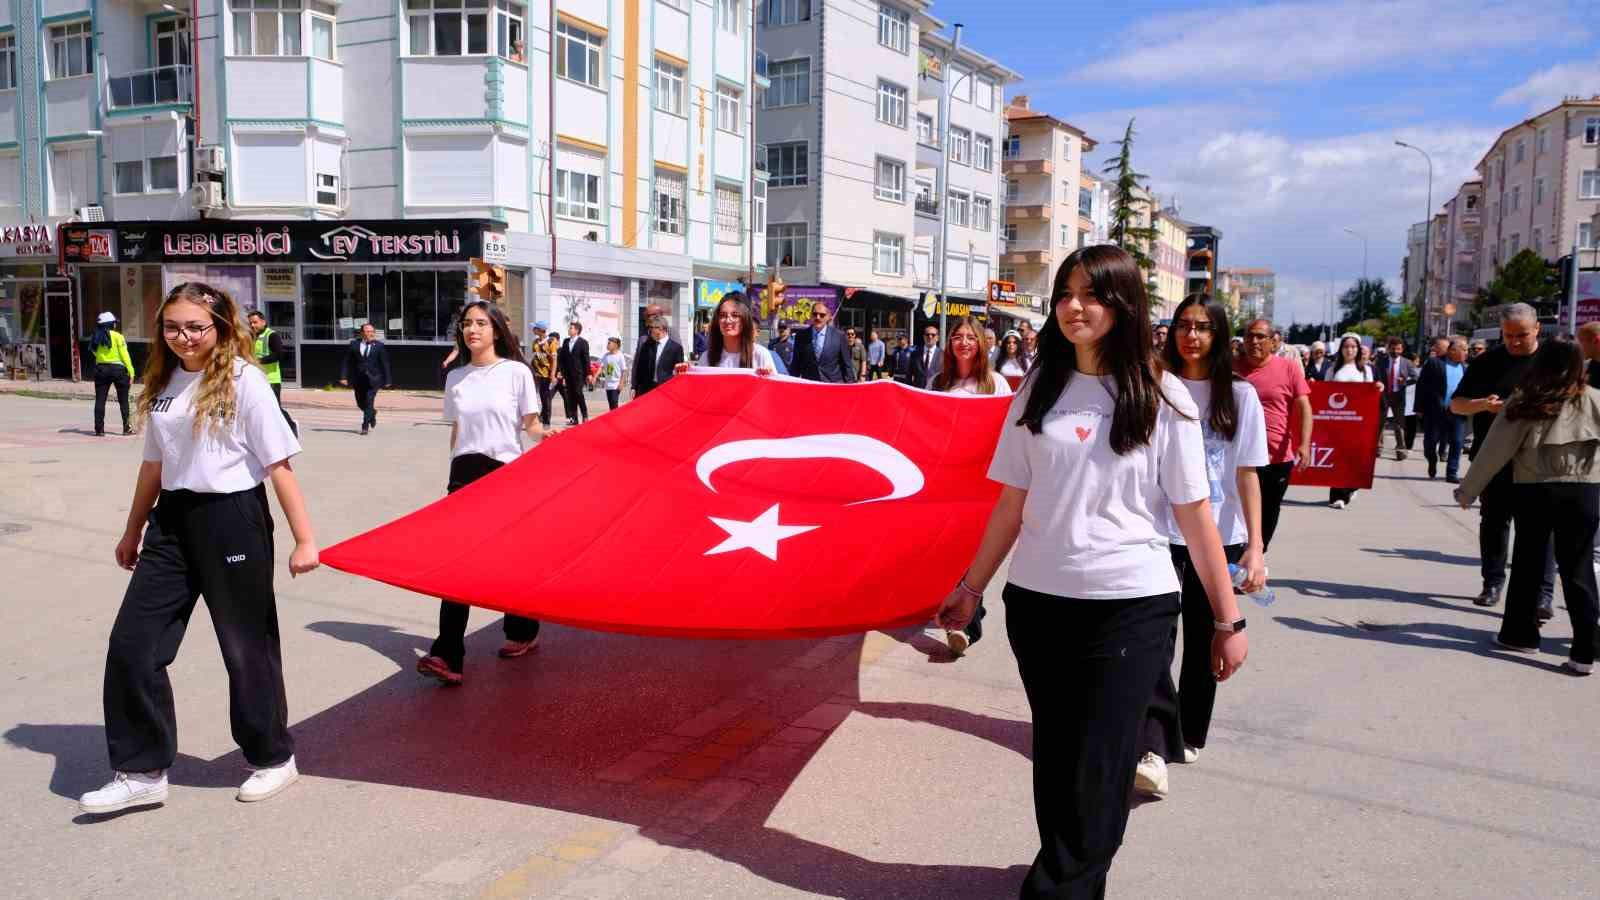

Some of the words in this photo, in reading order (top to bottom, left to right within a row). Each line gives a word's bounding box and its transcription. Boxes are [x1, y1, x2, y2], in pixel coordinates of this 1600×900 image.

[163, 226, 291, 255] LEBLEBİCİ
[333, 236, 358, 254] EV
[368, 229, 460, 254] TEKSTİLİ
[226, 554, 246, 564] VOID
